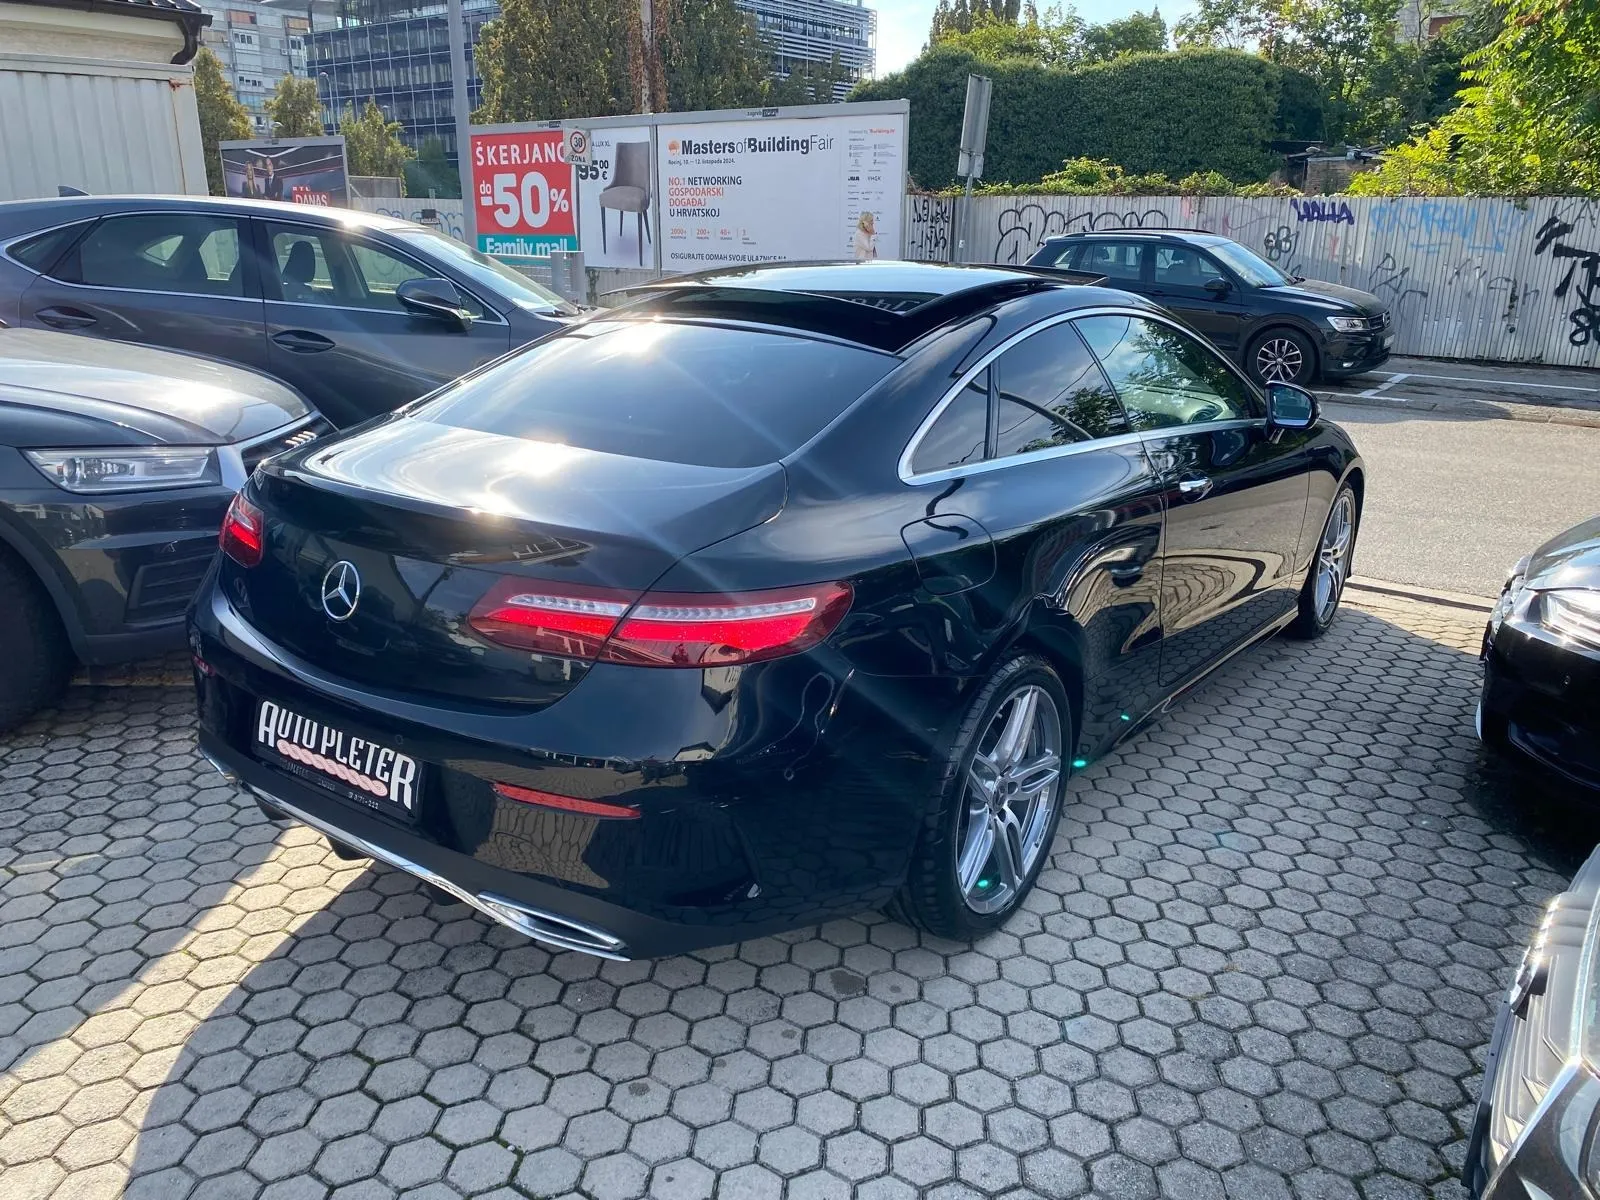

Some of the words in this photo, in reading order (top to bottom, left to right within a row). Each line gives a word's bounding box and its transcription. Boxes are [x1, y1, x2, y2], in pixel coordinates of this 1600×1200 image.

[573, 136, 583, 148] 30
[668, 177, 686, 186] NO.1
[687, 175, 742, 186] NETWORKING
[480, 180, 492, 195] do
[668, 186, 724, 196] GOSPODARSKI
[295, 194, 328, 207] DANAS
[669, 208, 675, 217] U
[676, 208, 720, 217] HRVATSKOJ
[486, 237, 533, 256] Family
[670, 252, 705, 260] OSIGURAJTE
[705, 253, 728, 261] ODMAH
[728, 254, 747, 262] SVOJE
[258, 700, 318, 749] AUTO
[320, 726, 416, 810] PLETER
